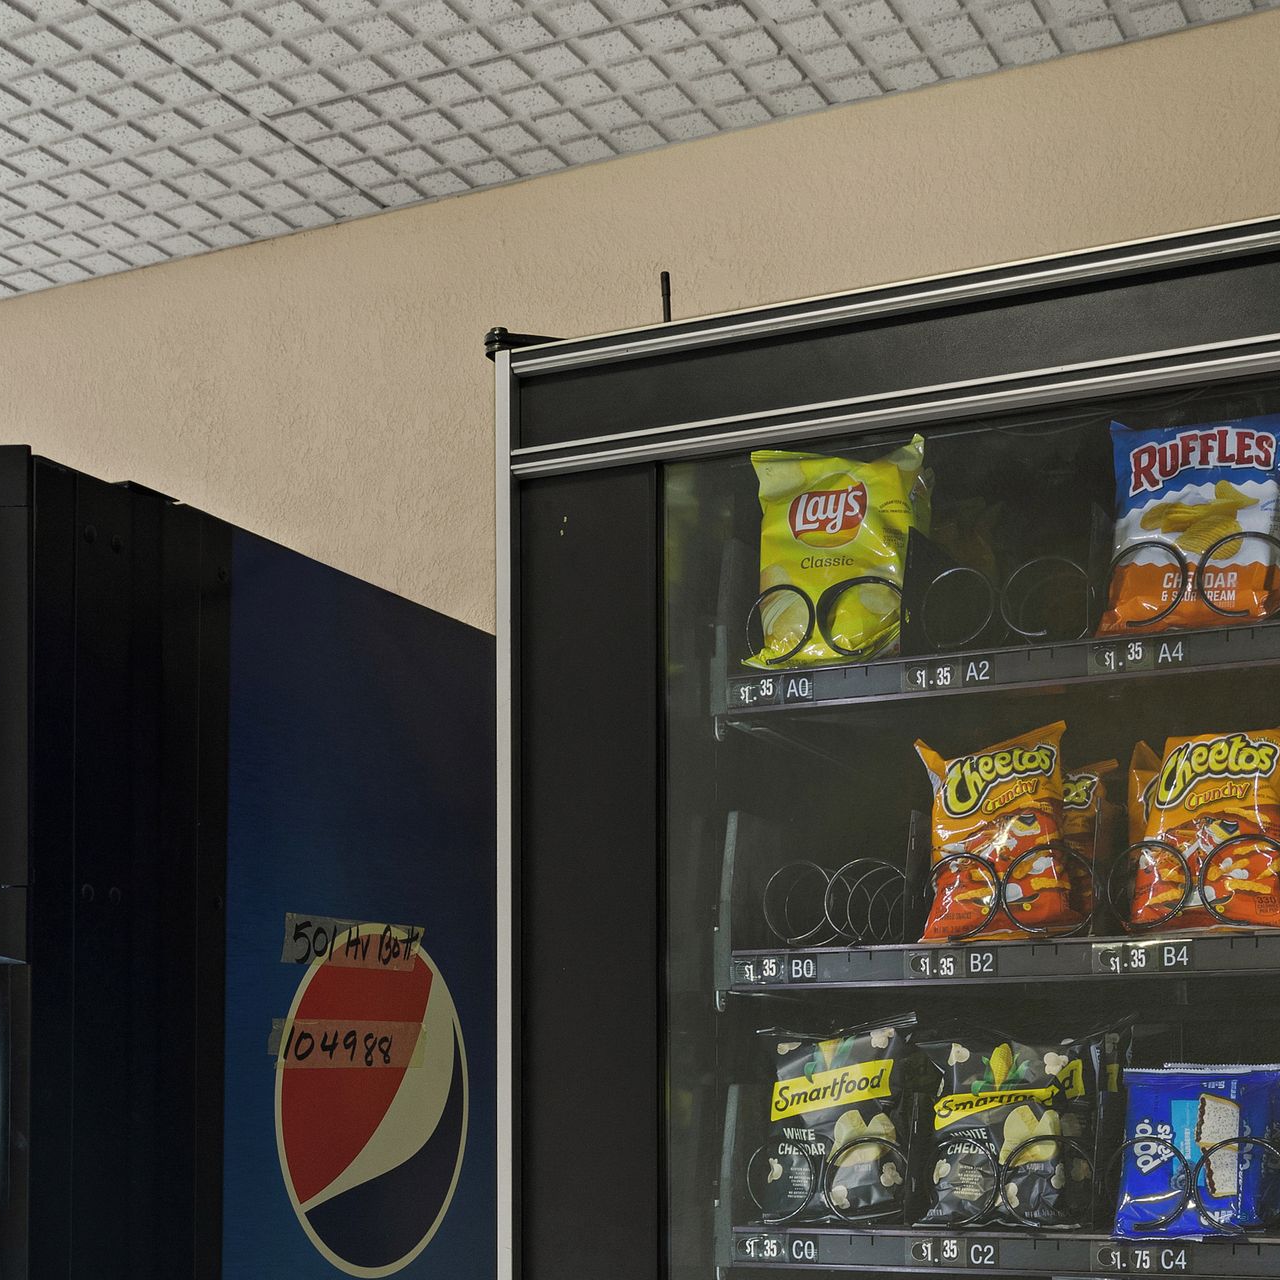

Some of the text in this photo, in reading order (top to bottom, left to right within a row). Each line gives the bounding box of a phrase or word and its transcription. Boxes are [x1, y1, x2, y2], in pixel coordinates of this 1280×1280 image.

[1131, 428, 1275, 496] RUFFLES
[795, 487, 863, 533] Lay's
[800, 555, 855, 570] Classic
[1158, 641, 1184, 663] A4
[965, 660, 990, 681] A2
[786, 677, 809, 698] A0
[944, 745, 1057, 815] Cheetos
[1158, 735, 1279, 806] Cheetos
[981, 777, 1038, 814] Crunchy
[1185, 781, 1251, 810] Crunchy
[970, 952, 994, 973] B2
[1163, 946, 1189, 966] B4
[791, 959, 813, 978] B0
[283, 1025, 393, 1067] 104988
[774, 1068, 885, 1112] Smartfood
[782, 1127, 815, 1142] WHITE
[792, 1240, 815, 1259] C0
[970, 1245, 994, 1265] C2
[1161, 1250, 1186, 1269] C4
